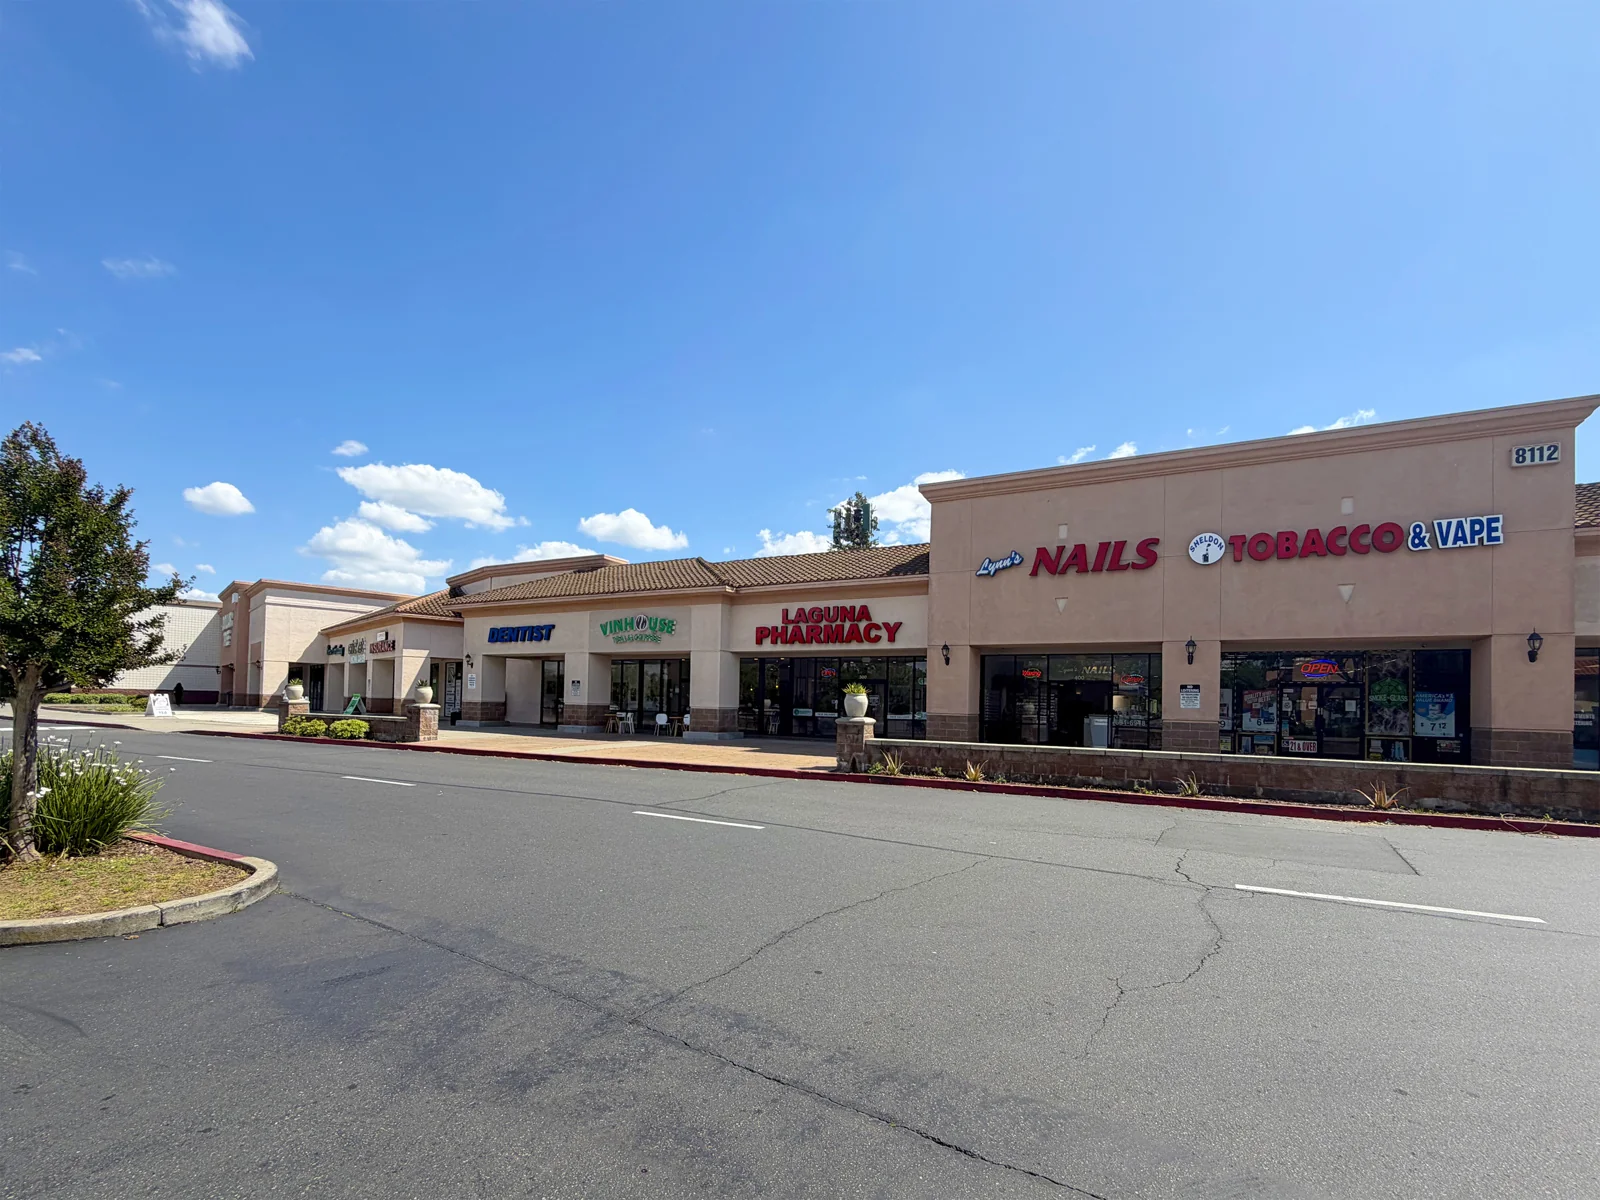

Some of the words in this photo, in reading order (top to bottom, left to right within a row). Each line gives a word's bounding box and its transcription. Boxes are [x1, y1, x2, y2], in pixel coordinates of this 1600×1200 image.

[1514, 444, 1559, 464] 8112
[1191, 535, 1224, 553] SHELDON
[1228, 522, 1404, 562] TOBACCO
[1407, 521, 1432, 551] &
[1432, 514, 1504, 549] VAPE
[975, 550, 1024, 576] Lynn's
[1029, 537, 1160, 576] NAILS
[782, 605, 872, 624] LAGUNA
[488, 624, 555, 643] DENTIST
[755, 622, 902, 645] PHARMACY
[1081, 666, 1116, 674] NAILS
[1301, 663, 1338, 674] OPEN
[1430, 722, 1436, 731] 7
[1289, 741, 1297, 751] 21
[1302, 742, 1317, 752] OVER
